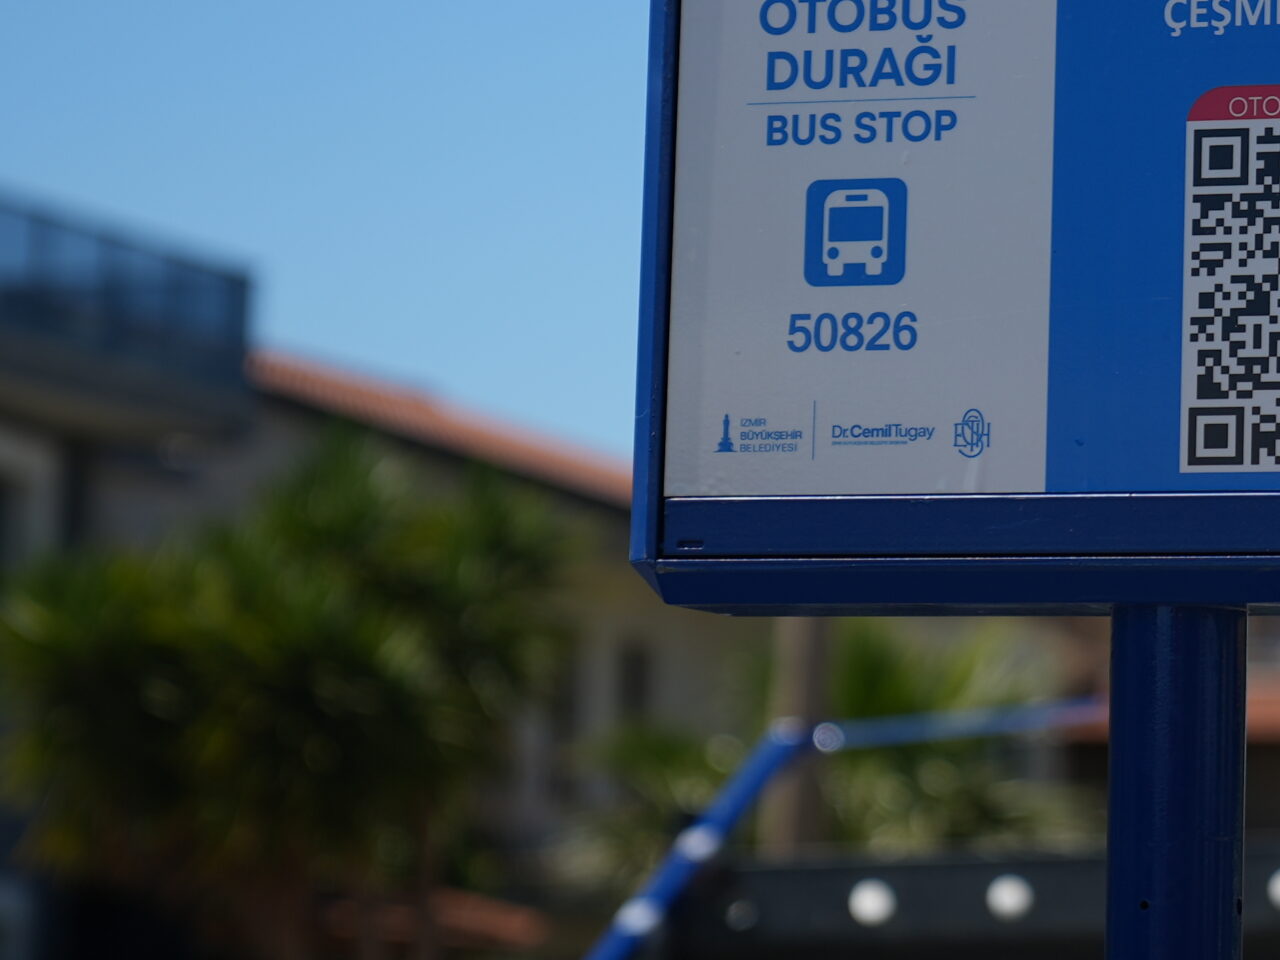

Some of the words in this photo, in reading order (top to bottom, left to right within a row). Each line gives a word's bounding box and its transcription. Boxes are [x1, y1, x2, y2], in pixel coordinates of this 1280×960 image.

[765, 34, 957, 91] DURAĞI
[766, 112, 842, 146] BUS
[853, 109, 958, 144] STOP
[787, 310, 918, 353] 50826
